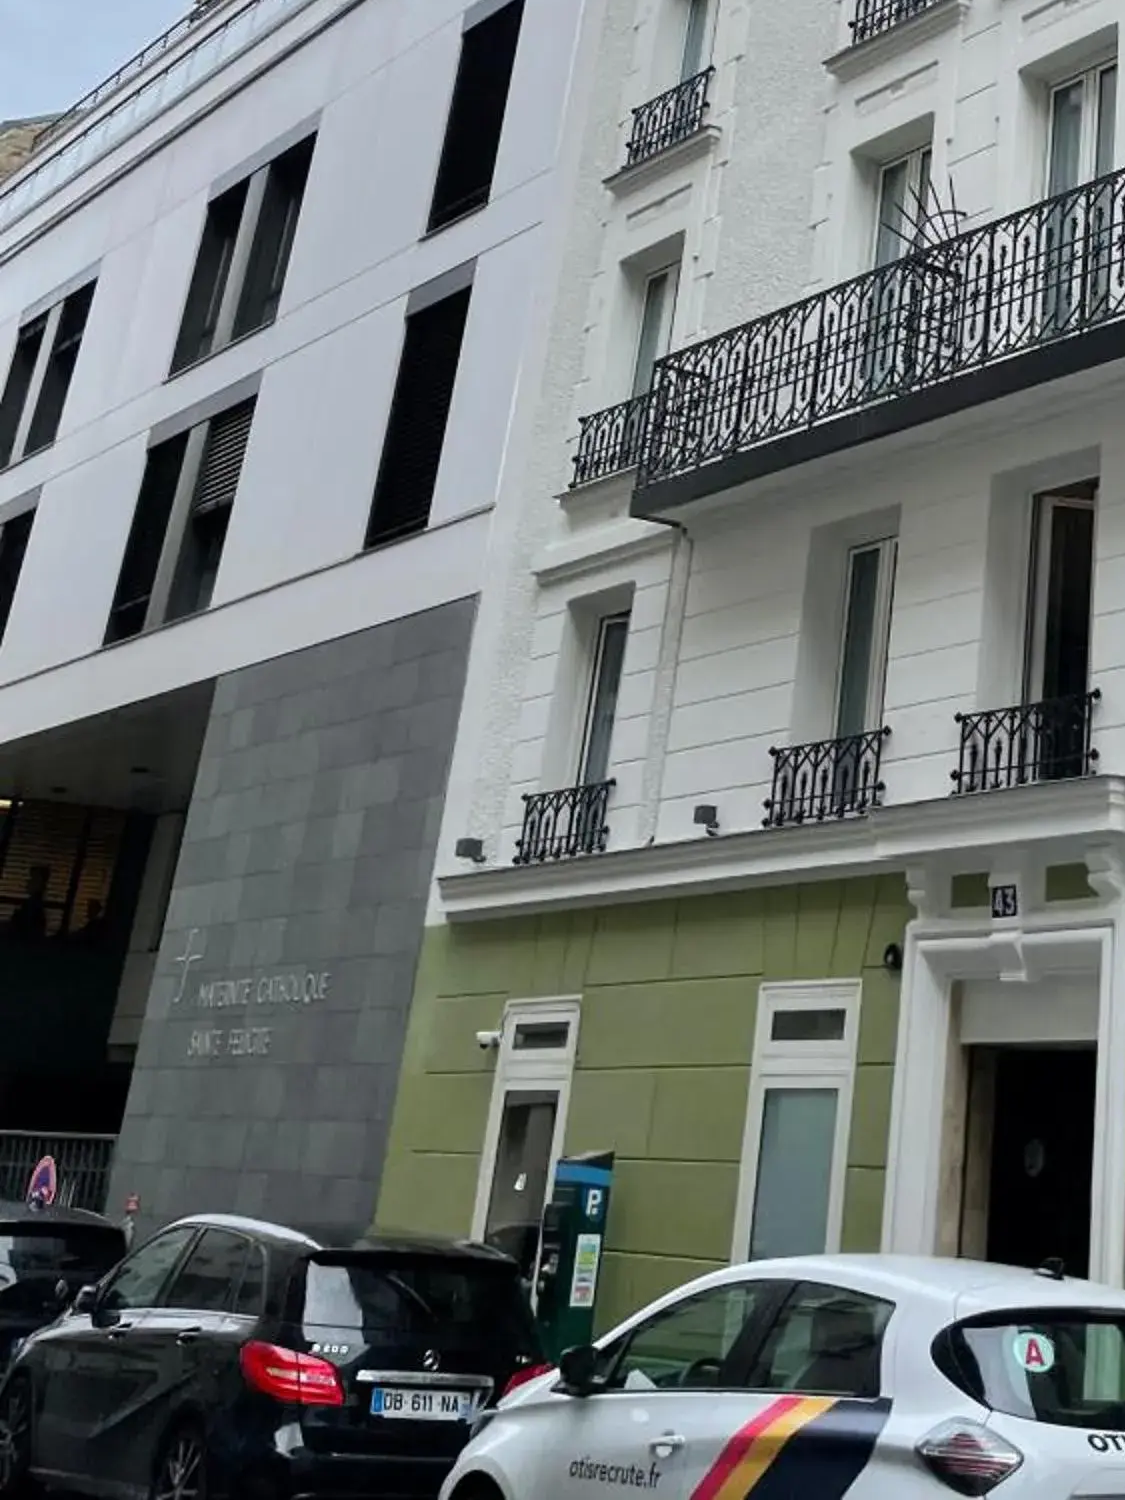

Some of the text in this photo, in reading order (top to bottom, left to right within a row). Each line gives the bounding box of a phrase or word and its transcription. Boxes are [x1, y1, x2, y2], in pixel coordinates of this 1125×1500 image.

[993, 888, 1015, 916] 43
[1025, 1338, 1045, 1366] A
[568, 1455, 662, 1489] otisrecrute.fr
